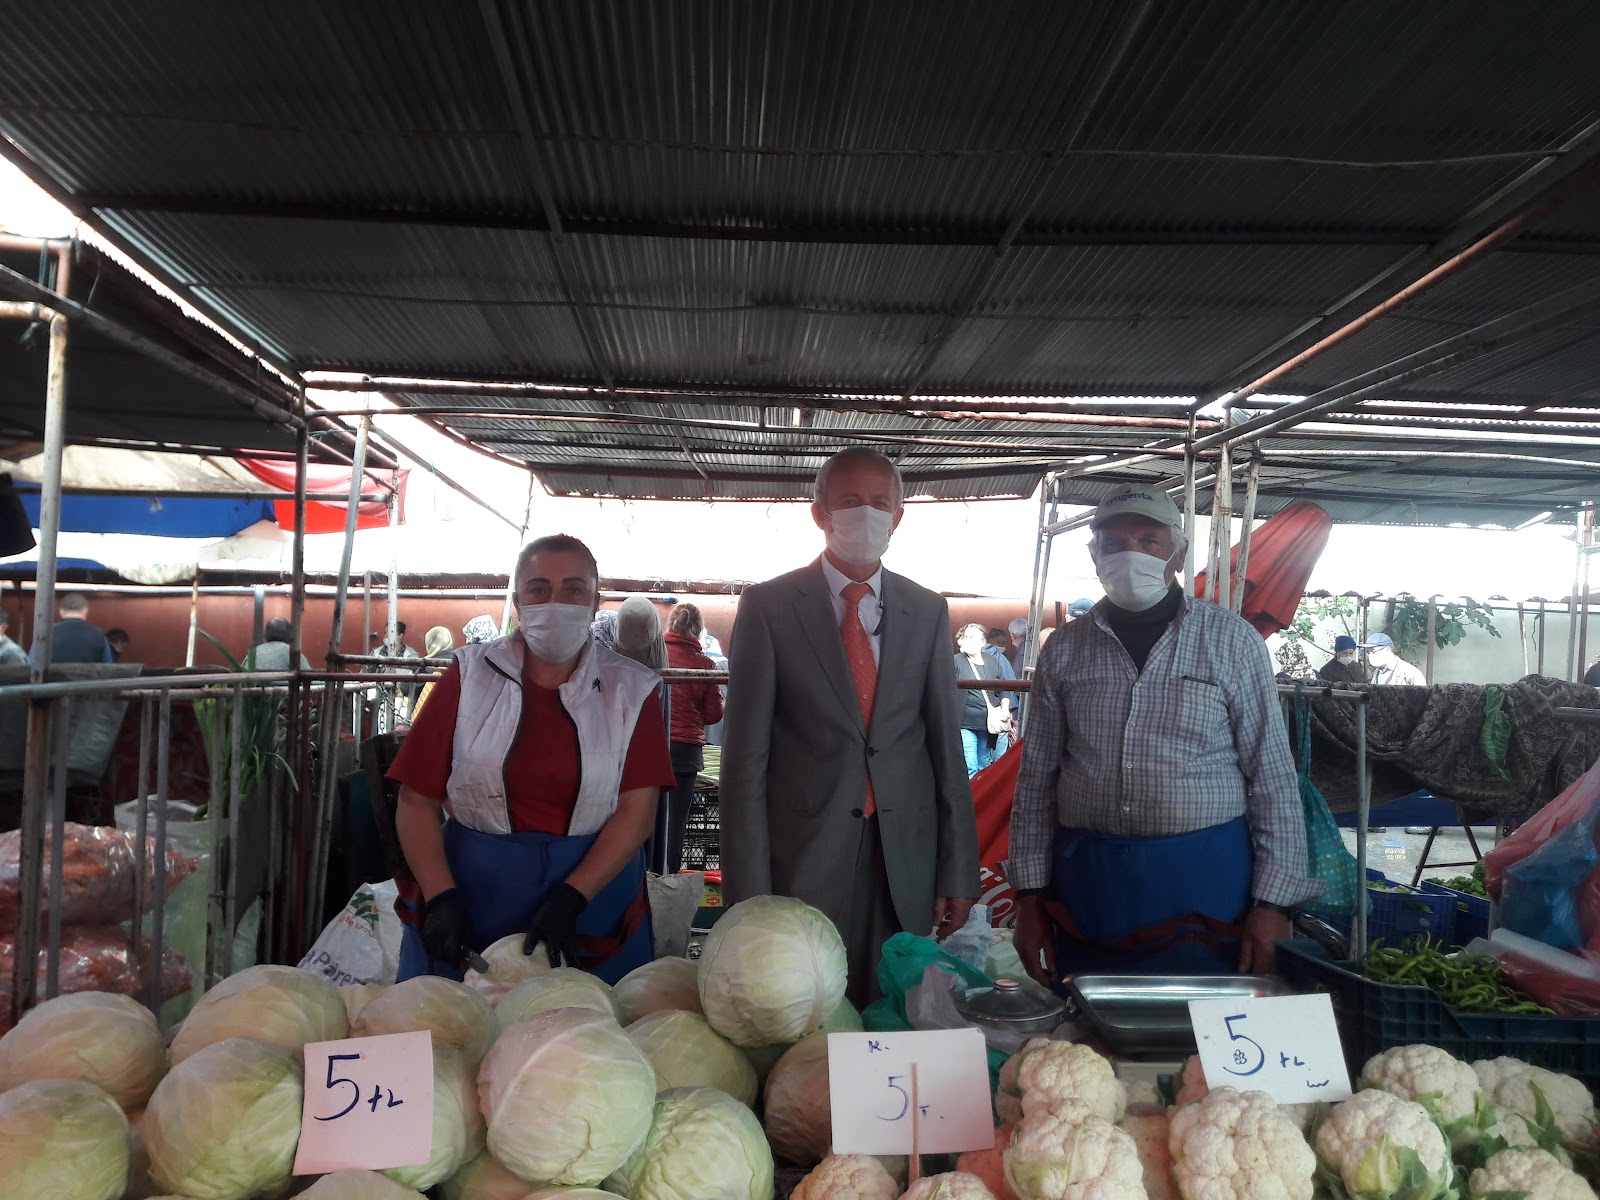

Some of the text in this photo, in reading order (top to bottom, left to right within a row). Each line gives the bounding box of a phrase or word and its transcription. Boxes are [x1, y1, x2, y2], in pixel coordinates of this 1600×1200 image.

[1223, 1013, 1265, 1076] 5
[313, 1053, 361, 1121] 5
[874, 1075, 909, 1122] 5
